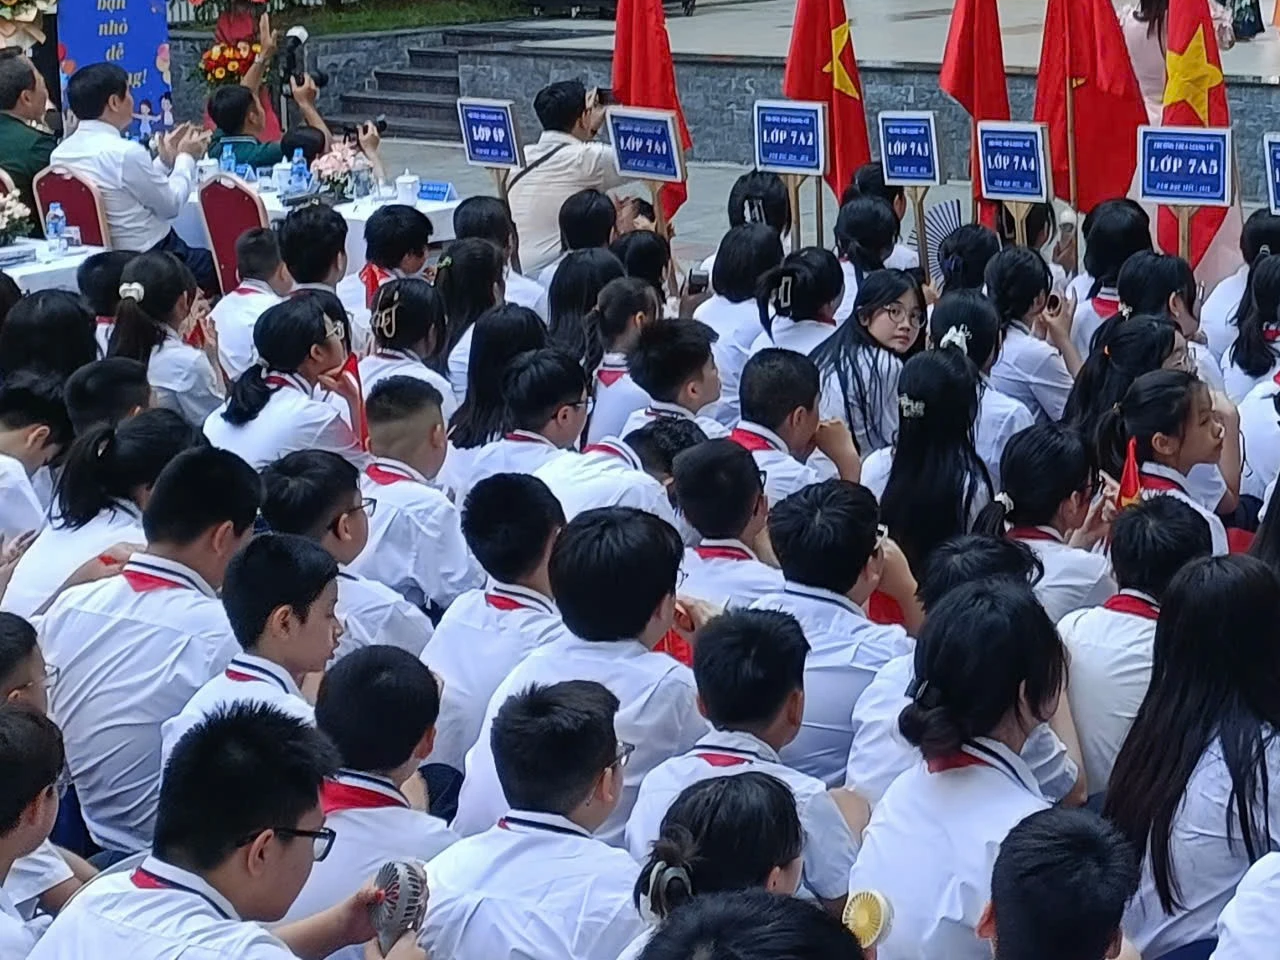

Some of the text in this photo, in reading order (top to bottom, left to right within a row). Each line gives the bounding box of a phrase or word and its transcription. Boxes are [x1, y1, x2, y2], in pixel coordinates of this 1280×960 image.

[98, 17, 129, 36] nhỏ
[620, 135, 643, 152] LỚP
[763, 127, 813, 146] LỚP 7A2
[888, 139, 929, 157] LỚP 7A3
[987, 151, 1035, 171] LỚP 7A4
[1150, 153, 1218, 175] LỚP 7A5
